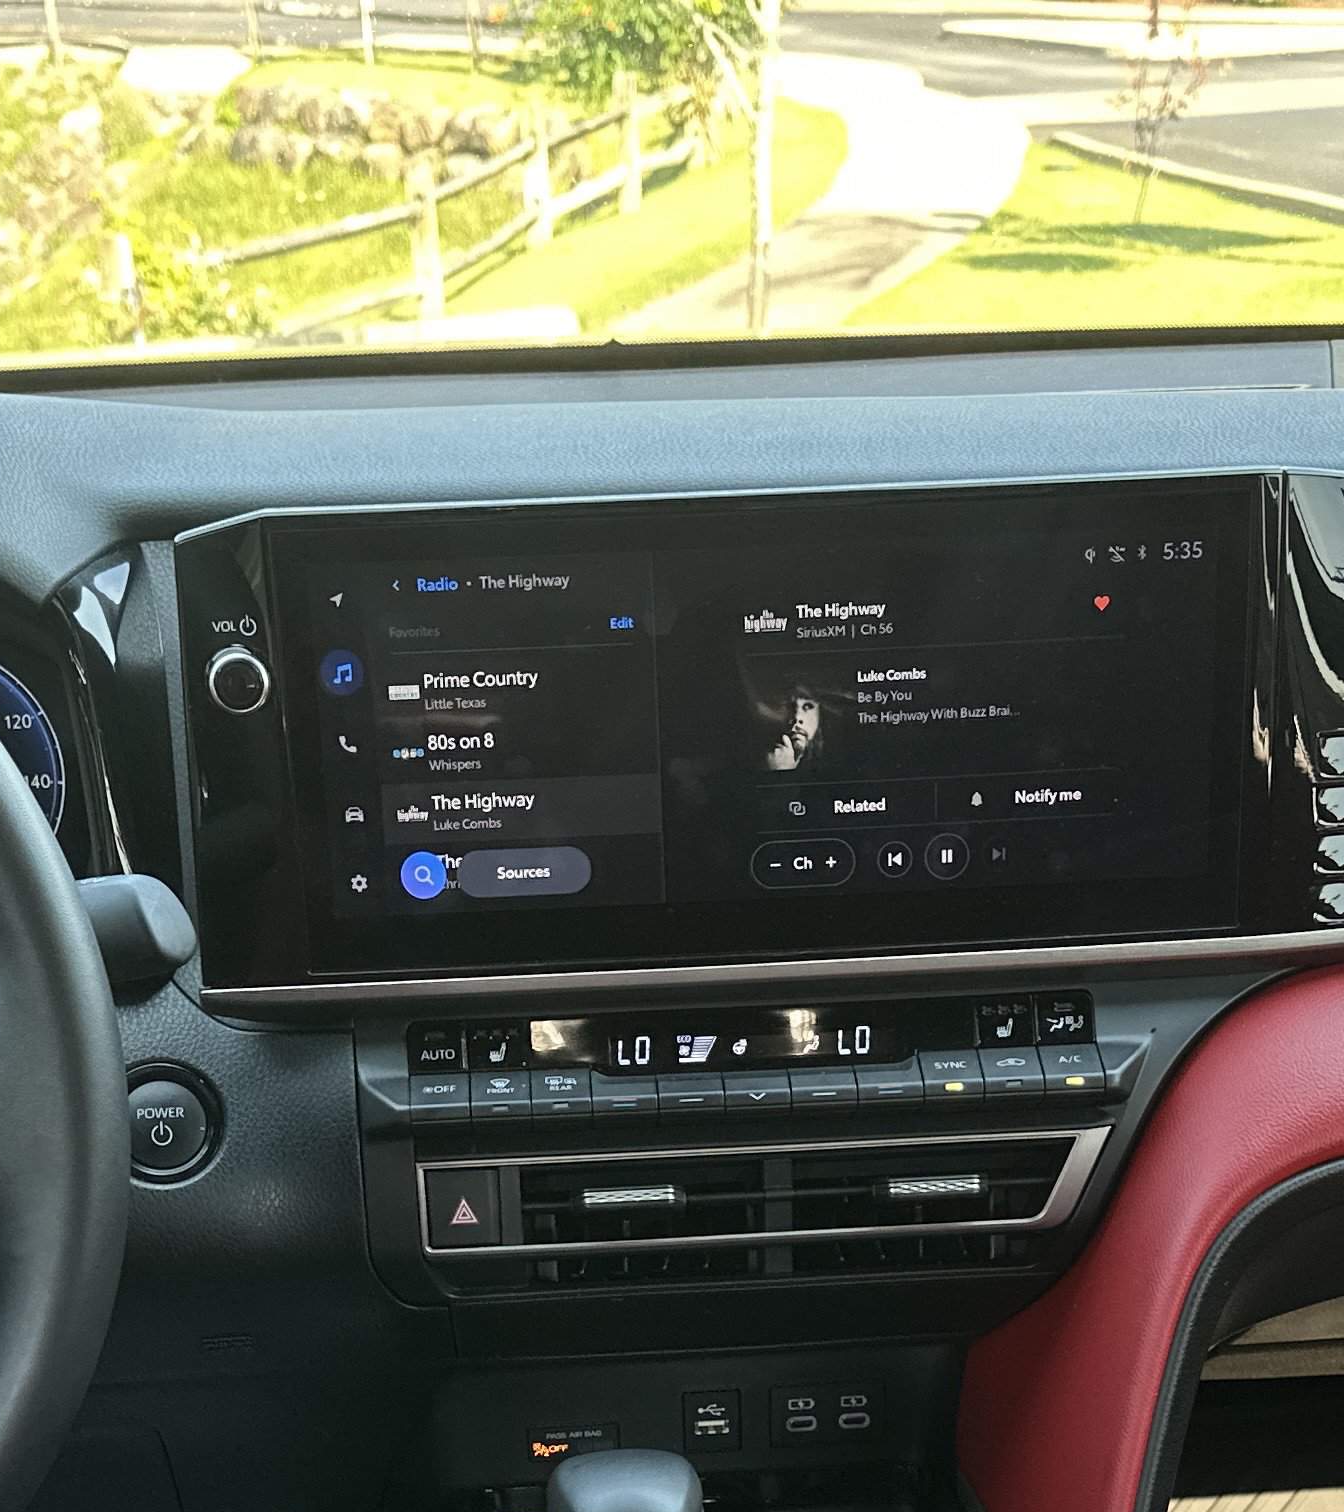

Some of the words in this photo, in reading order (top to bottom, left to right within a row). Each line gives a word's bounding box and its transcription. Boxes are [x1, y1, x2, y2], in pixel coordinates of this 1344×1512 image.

[1163, 541, 1203, 560] 5:35
[416, 577, 459, 592] Radio
[478, 575, 506, 590] The
[507, 574, 570, 592] Highway
[796, 604, 822, 619] The
[824, 602, 886, 620] Highway
[211, 620, 237, 634] VOL
[609, 616, 634, 630] Edit
[744, 614, 788, 632] highway
[388, 625, 441, 639] Favorites
[796, 625, 846, 639] SiriusXM
[860, 624, 877, 636] Ch
[879, 623, 894, 635] 56
[423, 672, 471, 689] Prime
[472, 670, 539, 689] Country
[857, 670, 885, 683] Luke
[886, 668, 927, 682] Combs
[424, 697, 454, 711] Little
[455, 696, 487, 709] Texas
[857, 691, 872, 704] Be
[874, 690, 889, 704] By
[889, 690, 913, 701] You
[4, 714, 32, 730] 120
[858, 711, 878, 724] The
[880, 710, 929, 725] Highway
[930, 707, 958, 720] With
[960, 707, 987, 719] Buzz
[427, 734, 456, 751] 80s
[459, 735, 481, 749] on
[484, 732, 494, 748] 8
[429, 757, 482, 773] Whispers
[431, 794, 462, 811] The
[464, 792, 535, 812] Highway
[1014, 787, 1056, 805] Notify
[1058, 790, 1082, 803] me
[834, 797, 887, 814] Related
[433, 818, 460, 831] Luke
[462, 817, 502, 830] Combs
[793, 855, 813, 871] Ch
[497, 866, 550, 880] Sources
[420, 1048, 456, 1061] AUTO
[1058, 1054, 1082, 1064] A/C
[934, 1060, 967, 1070] SYNC
[433, 1084, 457, 1094] OFF
[136, 1106, 185, 1120] POWER
